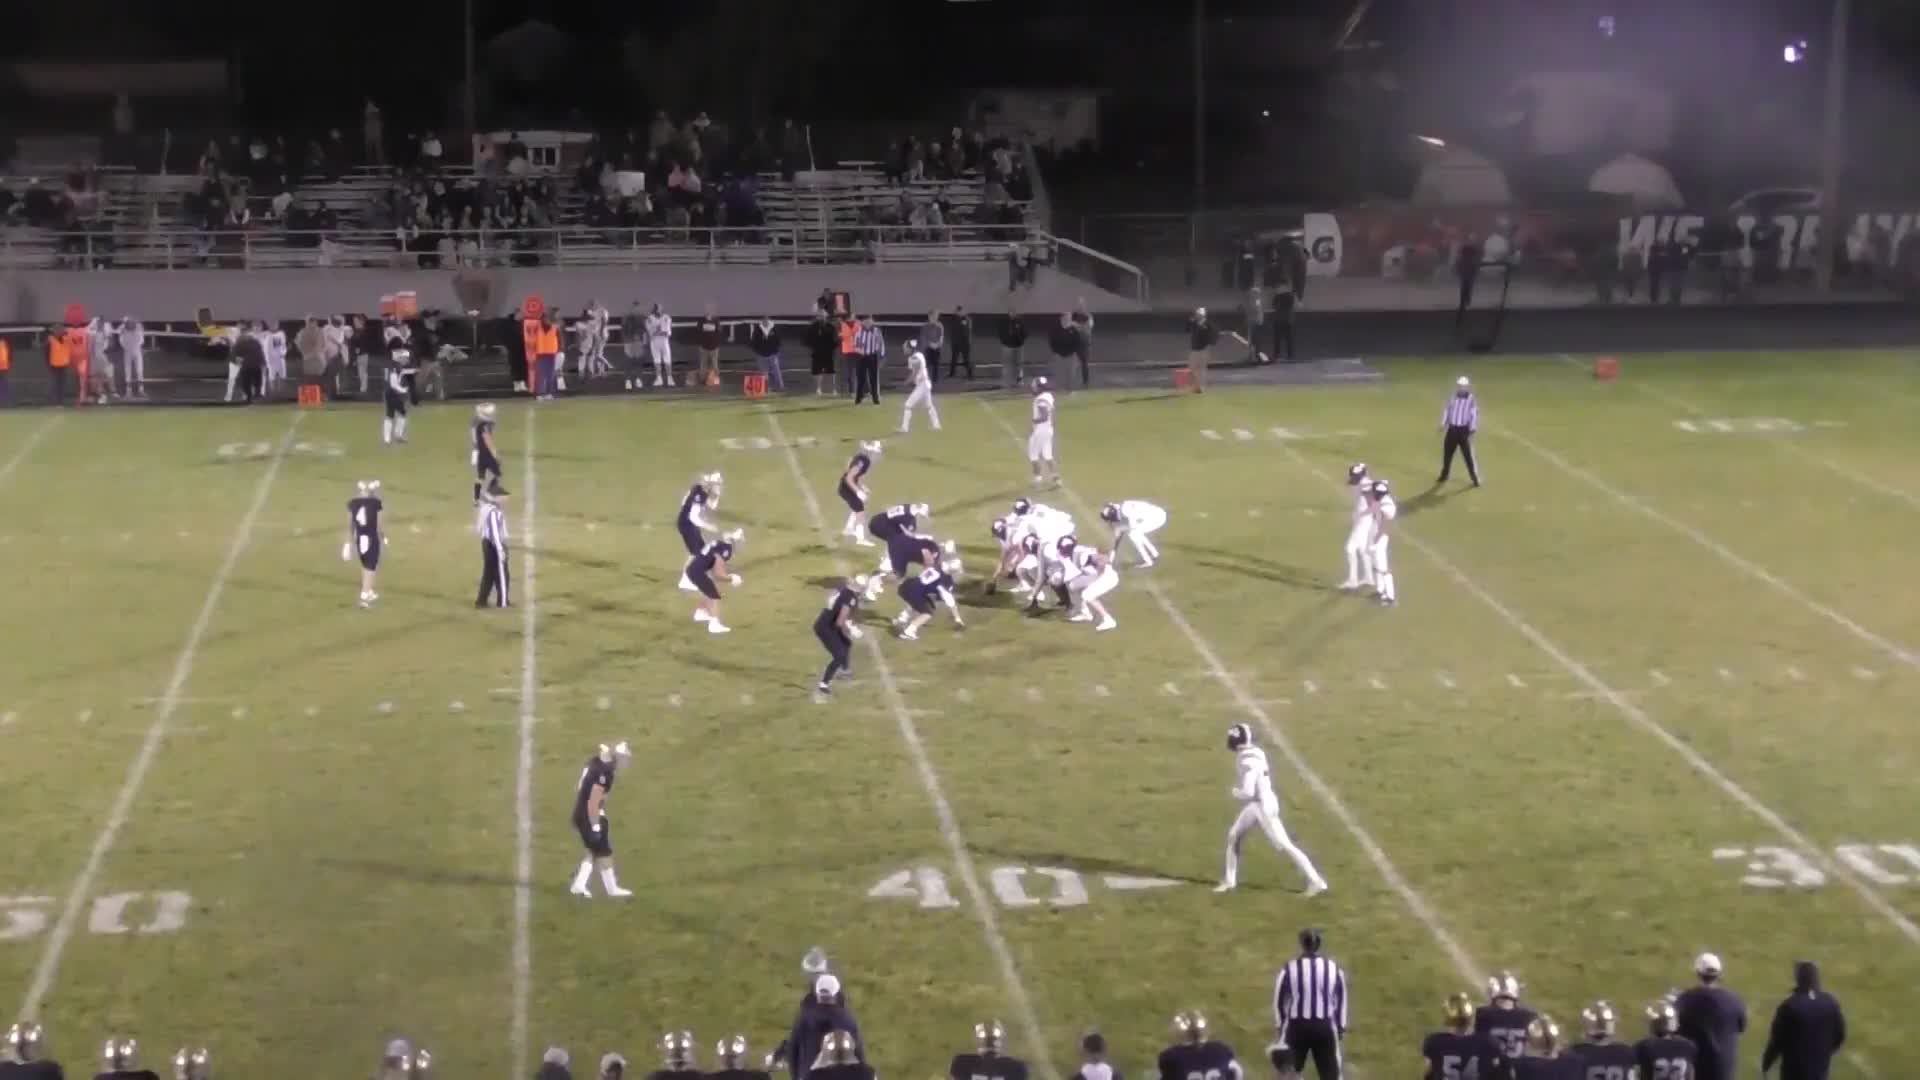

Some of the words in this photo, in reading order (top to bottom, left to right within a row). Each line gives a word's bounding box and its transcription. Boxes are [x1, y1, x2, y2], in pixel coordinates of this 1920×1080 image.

[1312, 236, 1336, 263] G
[356, 506, 367, 526] 4
[867, 866, 1089, 907] 40
